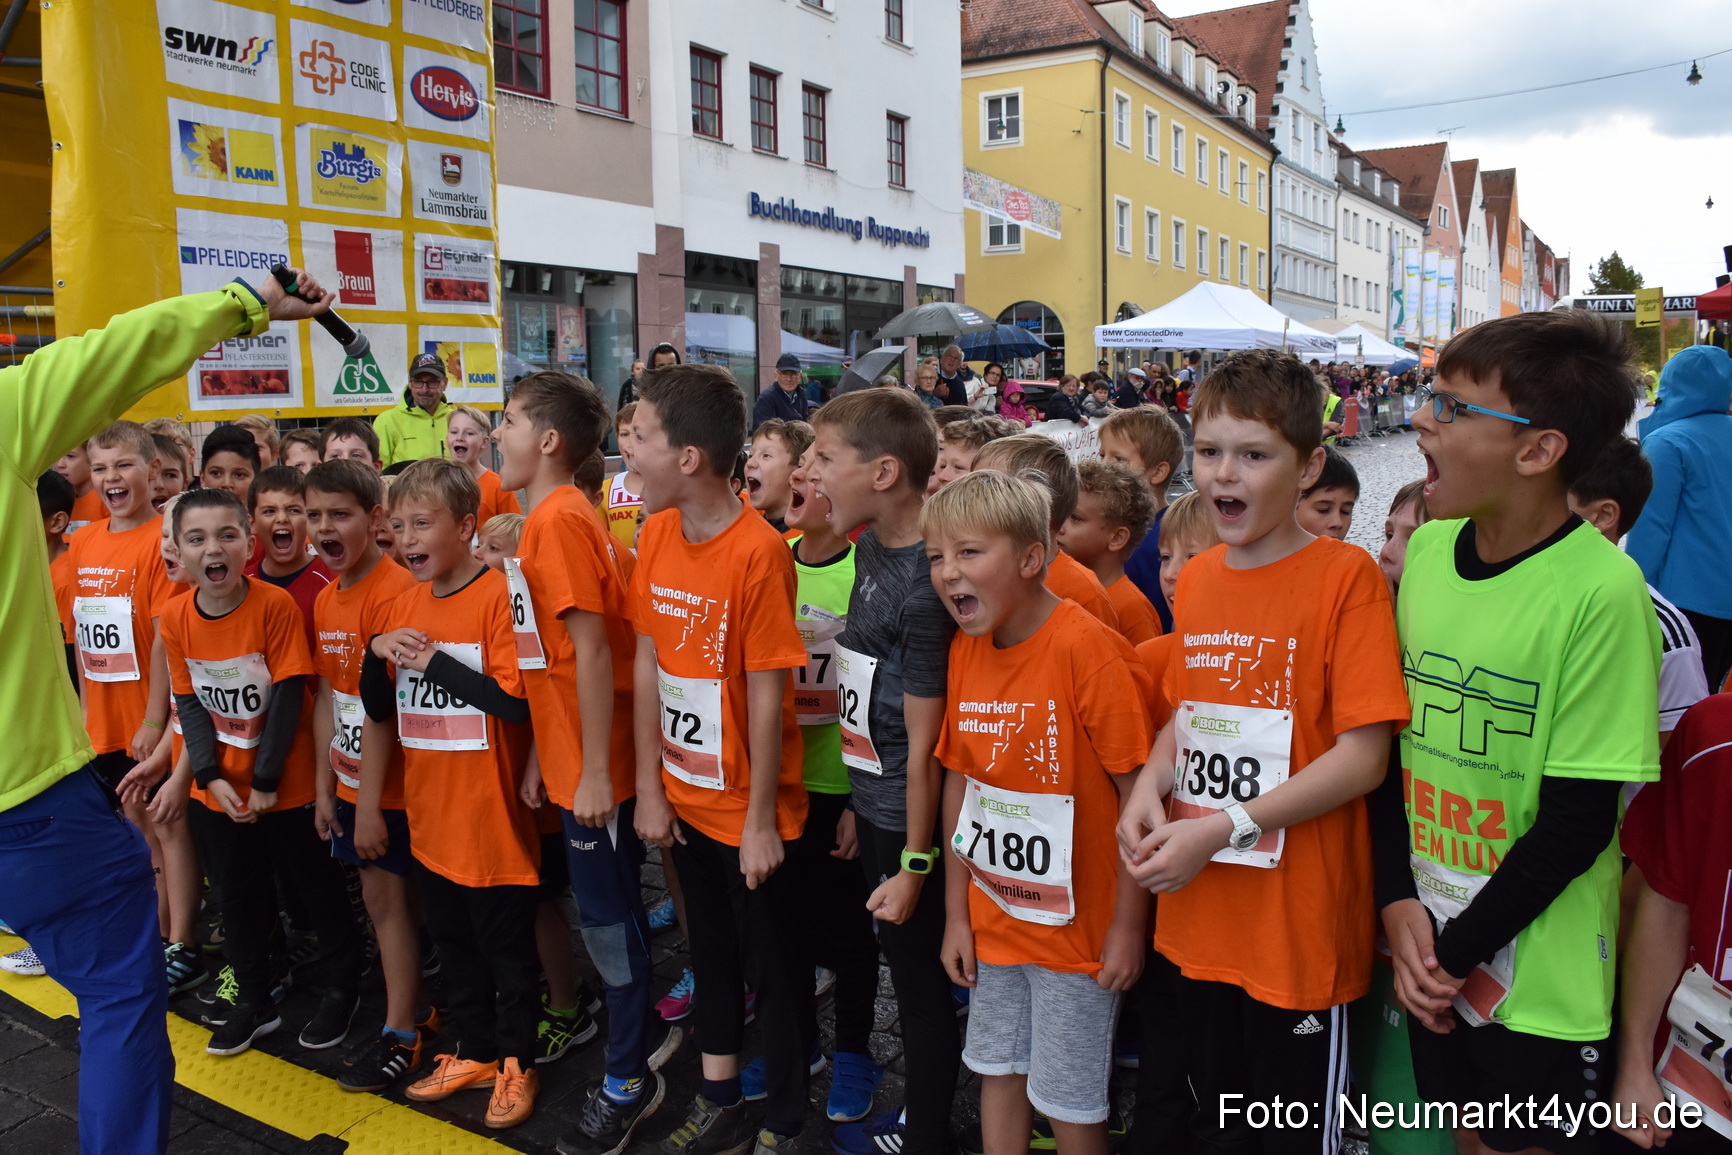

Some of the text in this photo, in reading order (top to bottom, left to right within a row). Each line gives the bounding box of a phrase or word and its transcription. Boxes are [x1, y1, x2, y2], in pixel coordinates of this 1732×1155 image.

[408, 0, 484, 23] LEIDERER
[165, 27, 238, 61] swn
[166, 50, 257, 76] stadtwerke neumarkt
[351, 61, 379, 79] CODE
[351, 75, 387, 94] CLINIC
[420, 74, 475, 110] Hervis
[235, 166, 275, 182] KANN
[339, 183, 359, 191] Feinste
[428, 188, 478, 204] Neumarkter
[421, 198, 487, 220] Lammsbräu
[749, 191, 930, 248] Buchhandlung Rupprecht
[338, 271, 373, 291] Braun
[1585, 300, 1622, 311] MINI
[1102, 328, 1184, 337] BMW ConnectedDrive
[225, 353, 288, 361] PFLASTERSTEINE
[468, 373, 496, 384] KANN
[610, 510, 633, 522] MAX
[79, 622, 120, 649] 7166
[1285, 637, 1297, 710] BAMBI
[201, 684, 261, 714] 7076
[959, 700, 1018, 714] eumarkter
[229, 721, 246, 732] Paul
[959, 718, 1005, 737] adtlauf
[1199, 717, 1241, 734] BOCK
[1047, 699, 1059, 784] BAMBINI
[1180, 747, 1261, 802] 7398
[988, 799, 1031, 816] BOCK
[967, 820, 1051, 876] 7180
[1421, 871, 1470, 901] BOCK
[1293, 1025, 1324, 1035] adidas
[1677, 1032, 1689, 1048] B6
